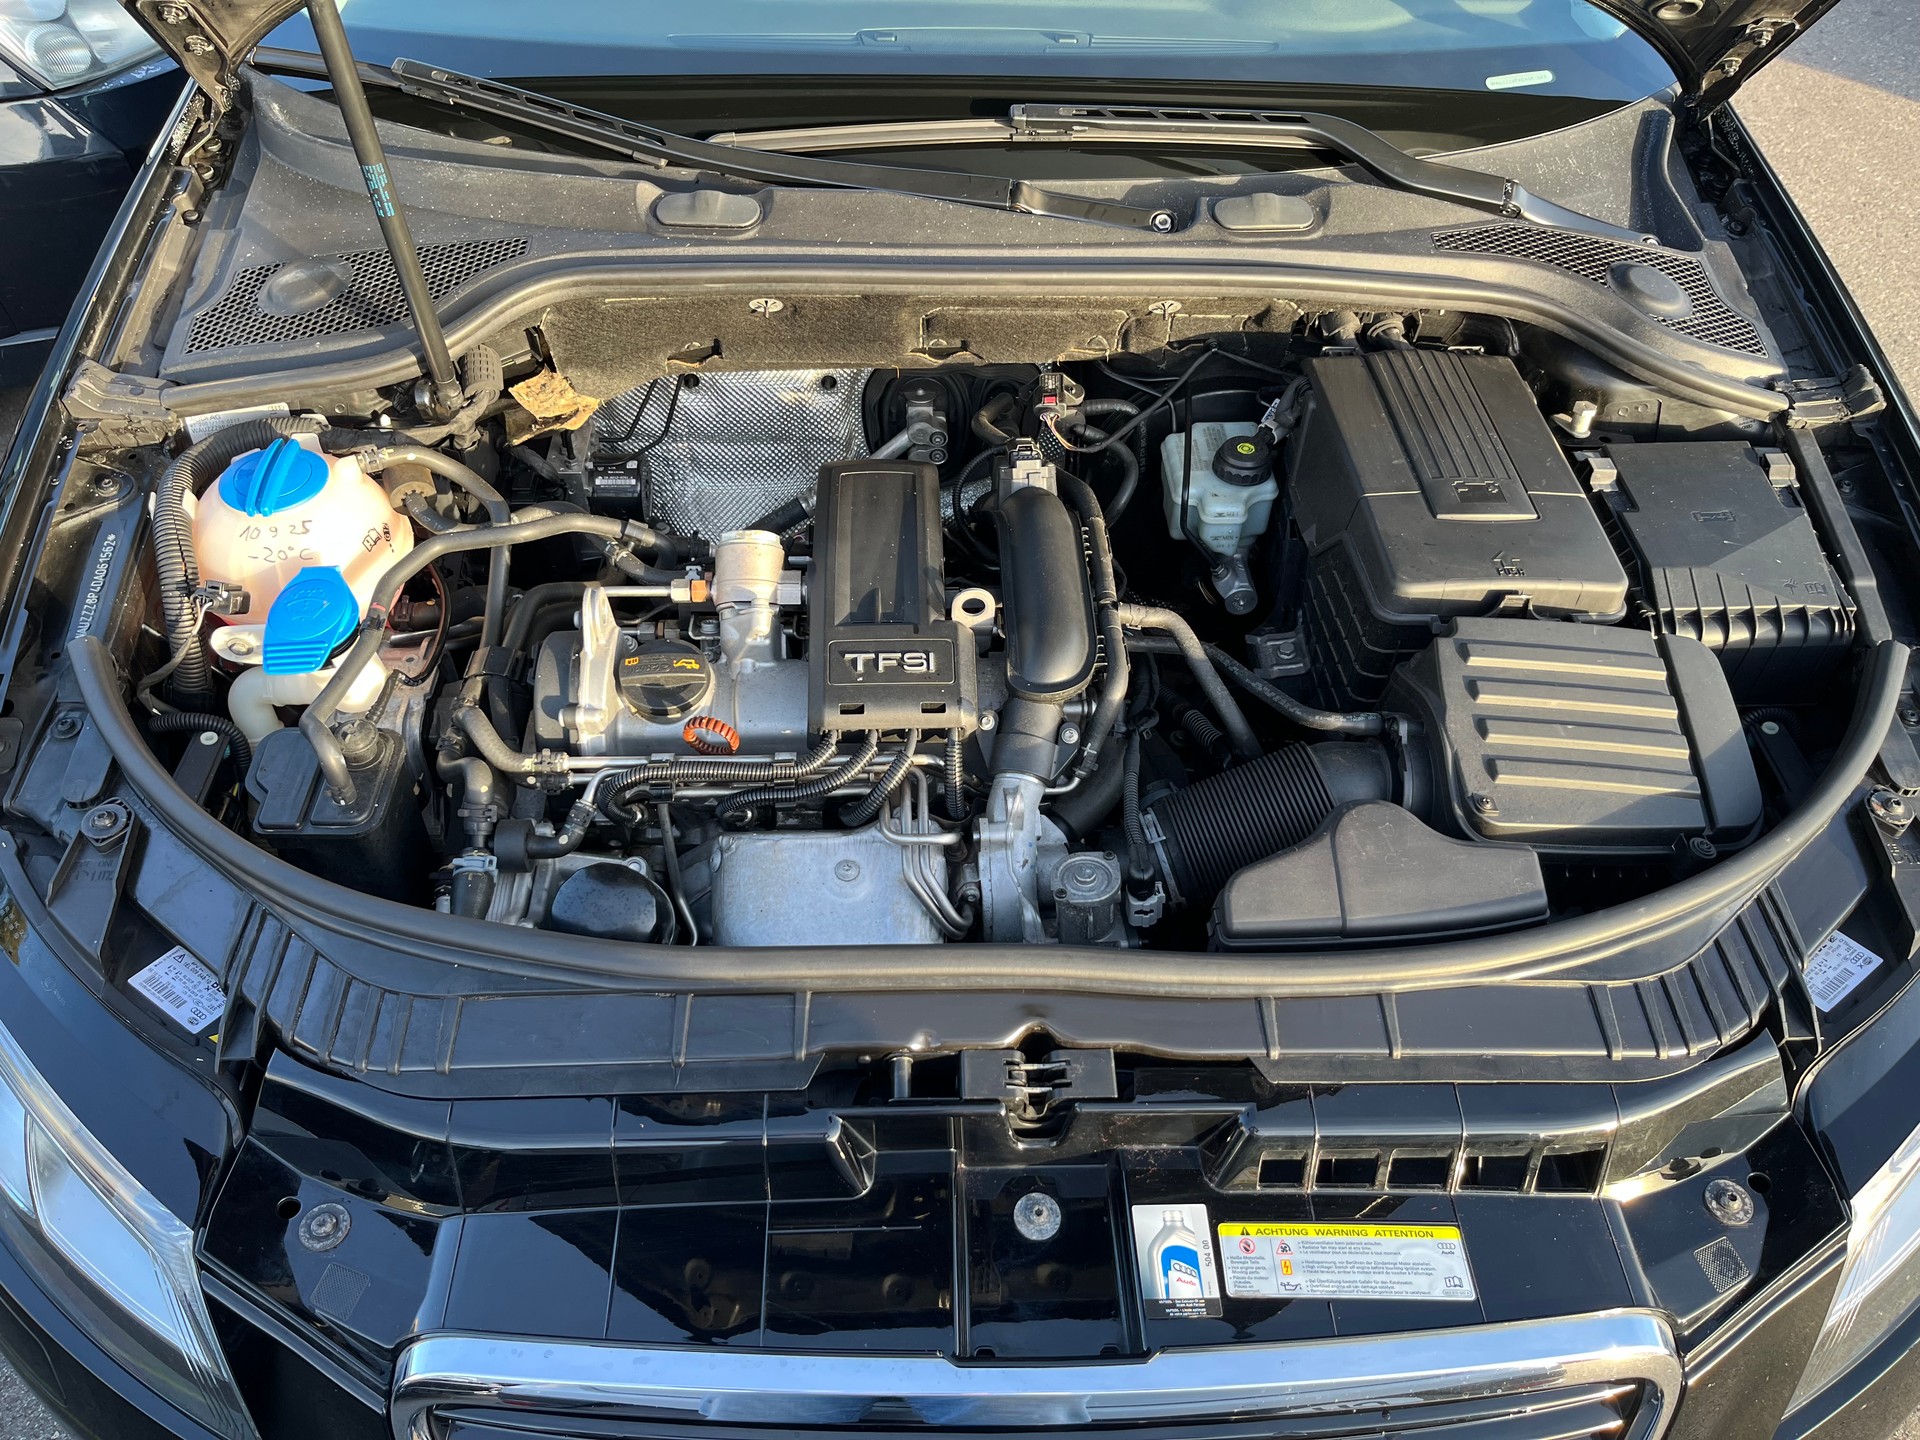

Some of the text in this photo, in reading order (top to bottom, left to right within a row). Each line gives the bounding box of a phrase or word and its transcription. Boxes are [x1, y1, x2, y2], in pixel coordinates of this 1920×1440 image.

[843, 652, 936, 674] TFSI
[1255, 1227, 1434, 1238] ACHTUNG WARNING ATTENTION
[1201, 1240, 1213, 1267] 504 00
